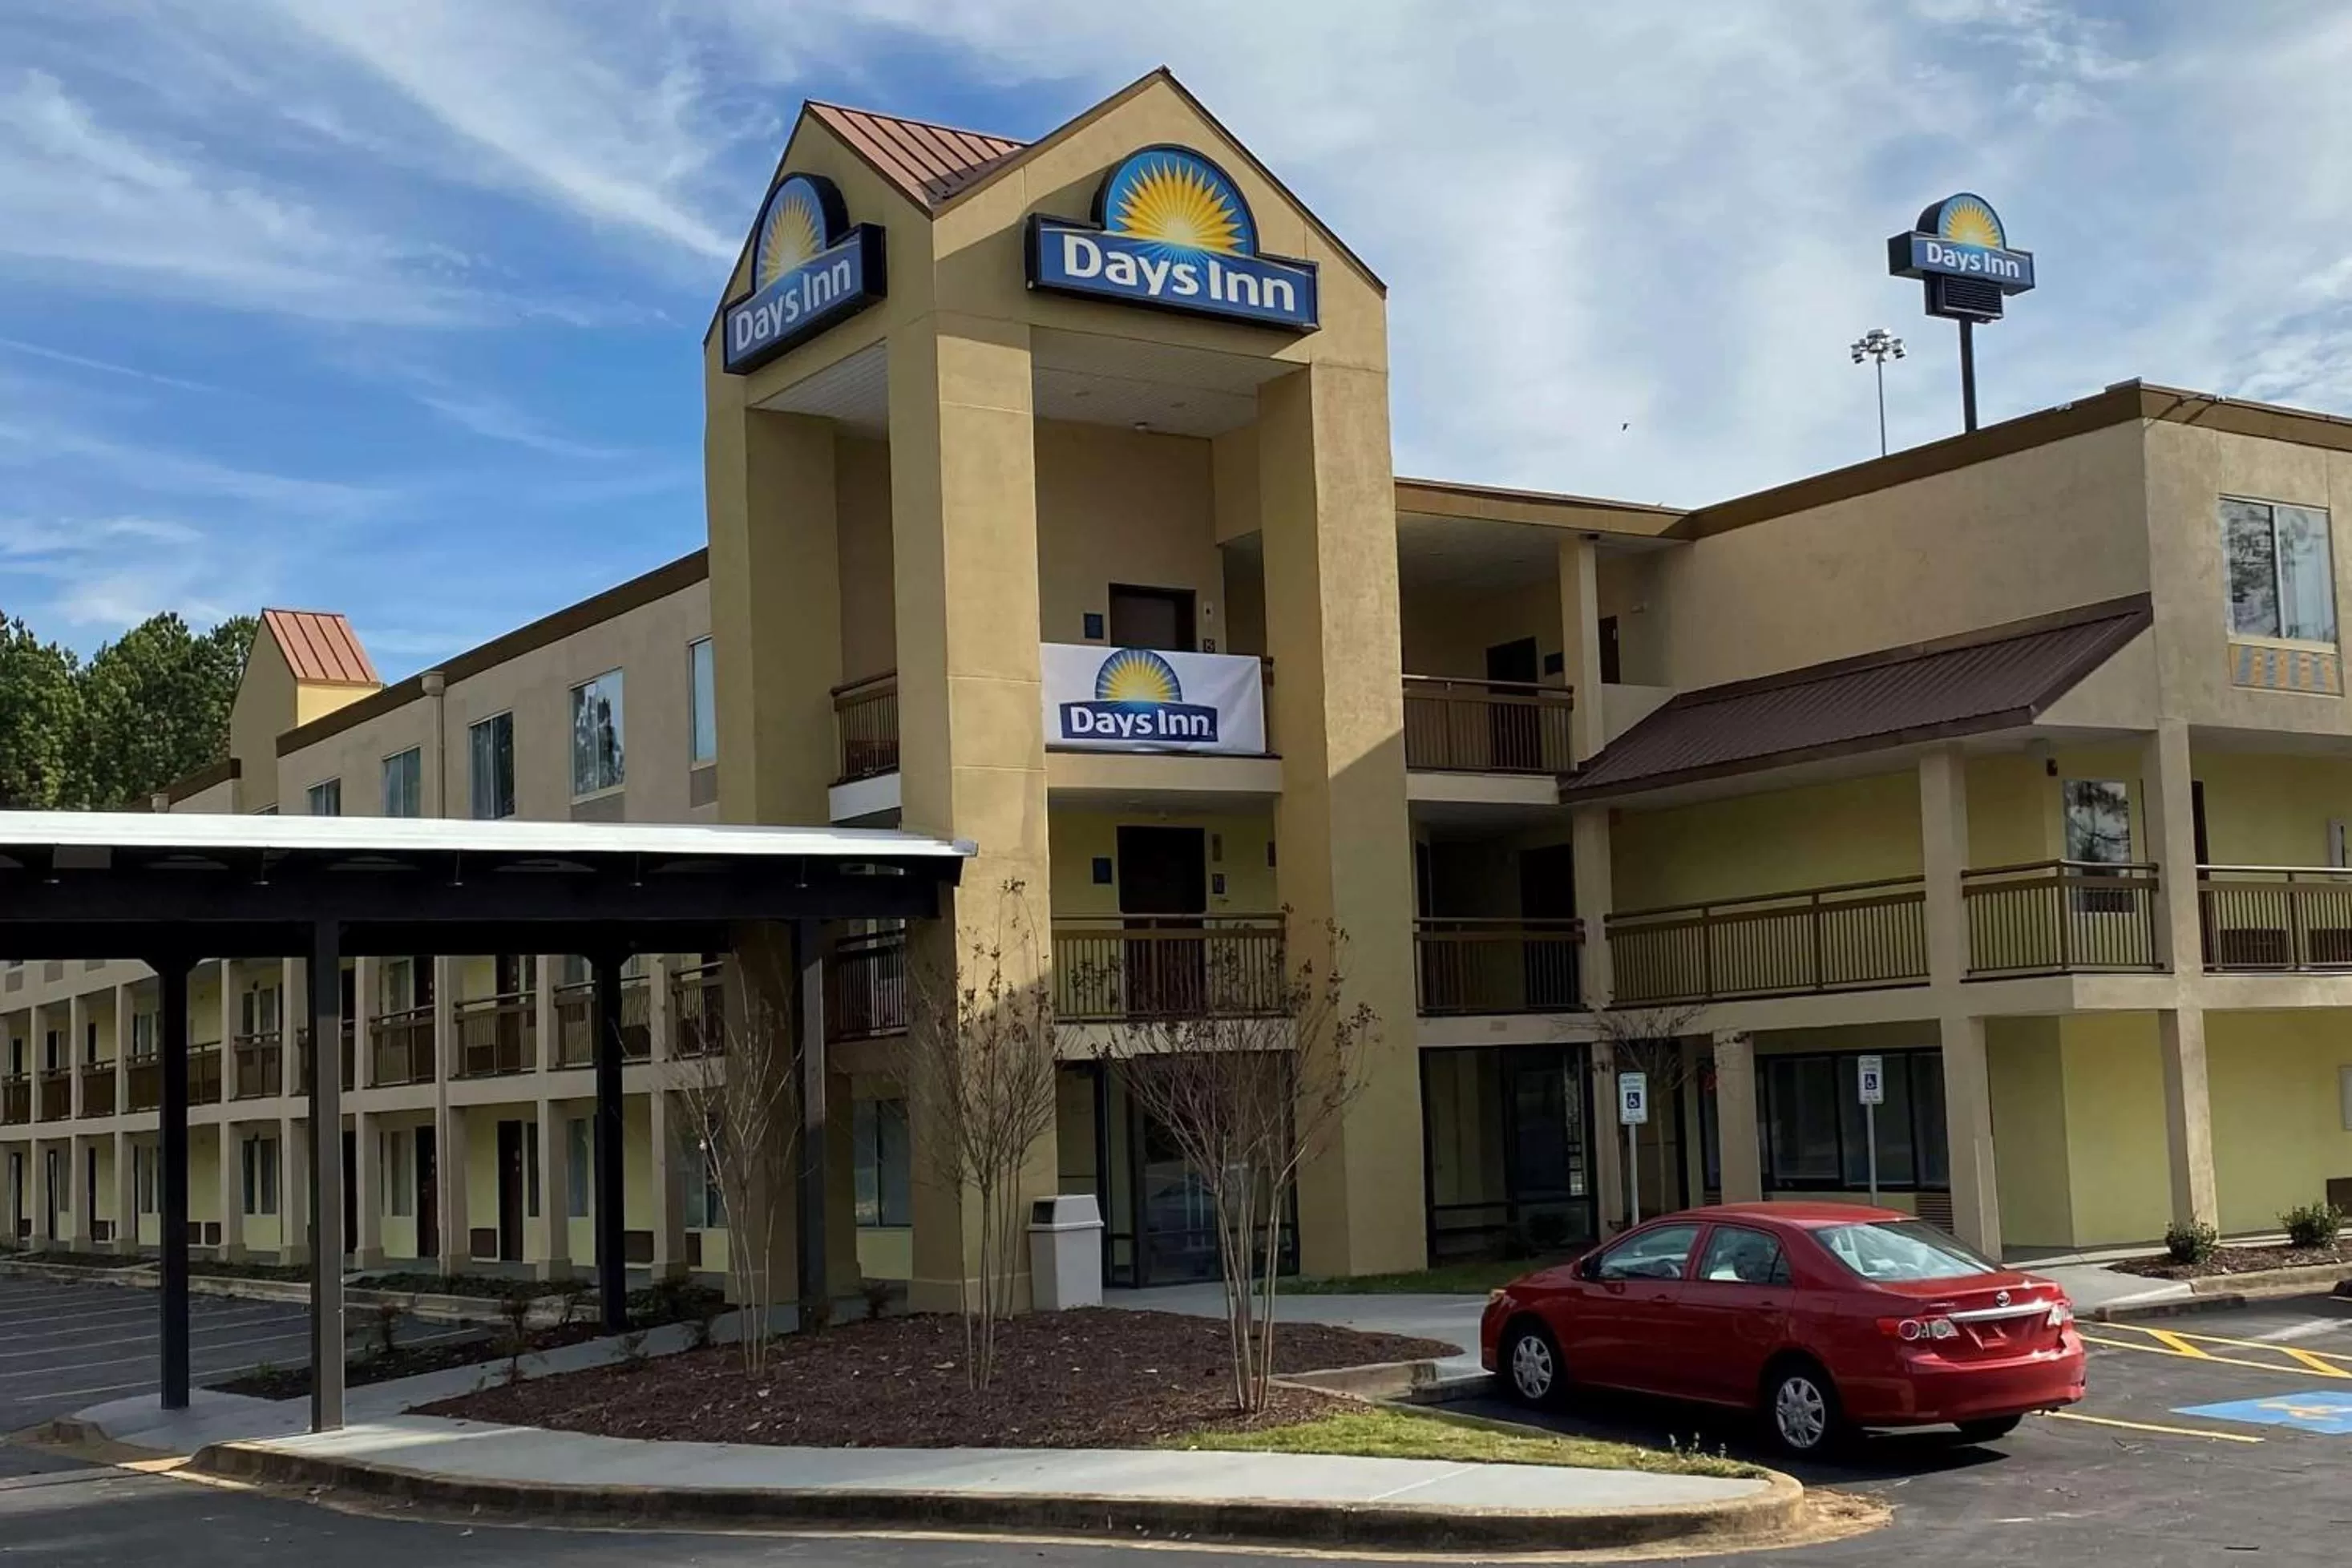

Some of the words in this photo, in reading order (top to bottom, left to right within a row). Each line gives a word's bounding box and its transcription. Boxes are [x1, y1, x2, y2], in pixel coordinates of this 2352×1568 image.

[1064, 235, 1200, 296] Days
[1209, 260, 1295, 311] Inn
[1926, 242, 1980, 272] Days
[1985, 253, 2019, 278] Inn
[735, 289, 798, 352] Days
[803, 259, 851, 312] Inn
[1070, 707, 1153, 738] Days
[1158, 709, 1210, 736] Inn
